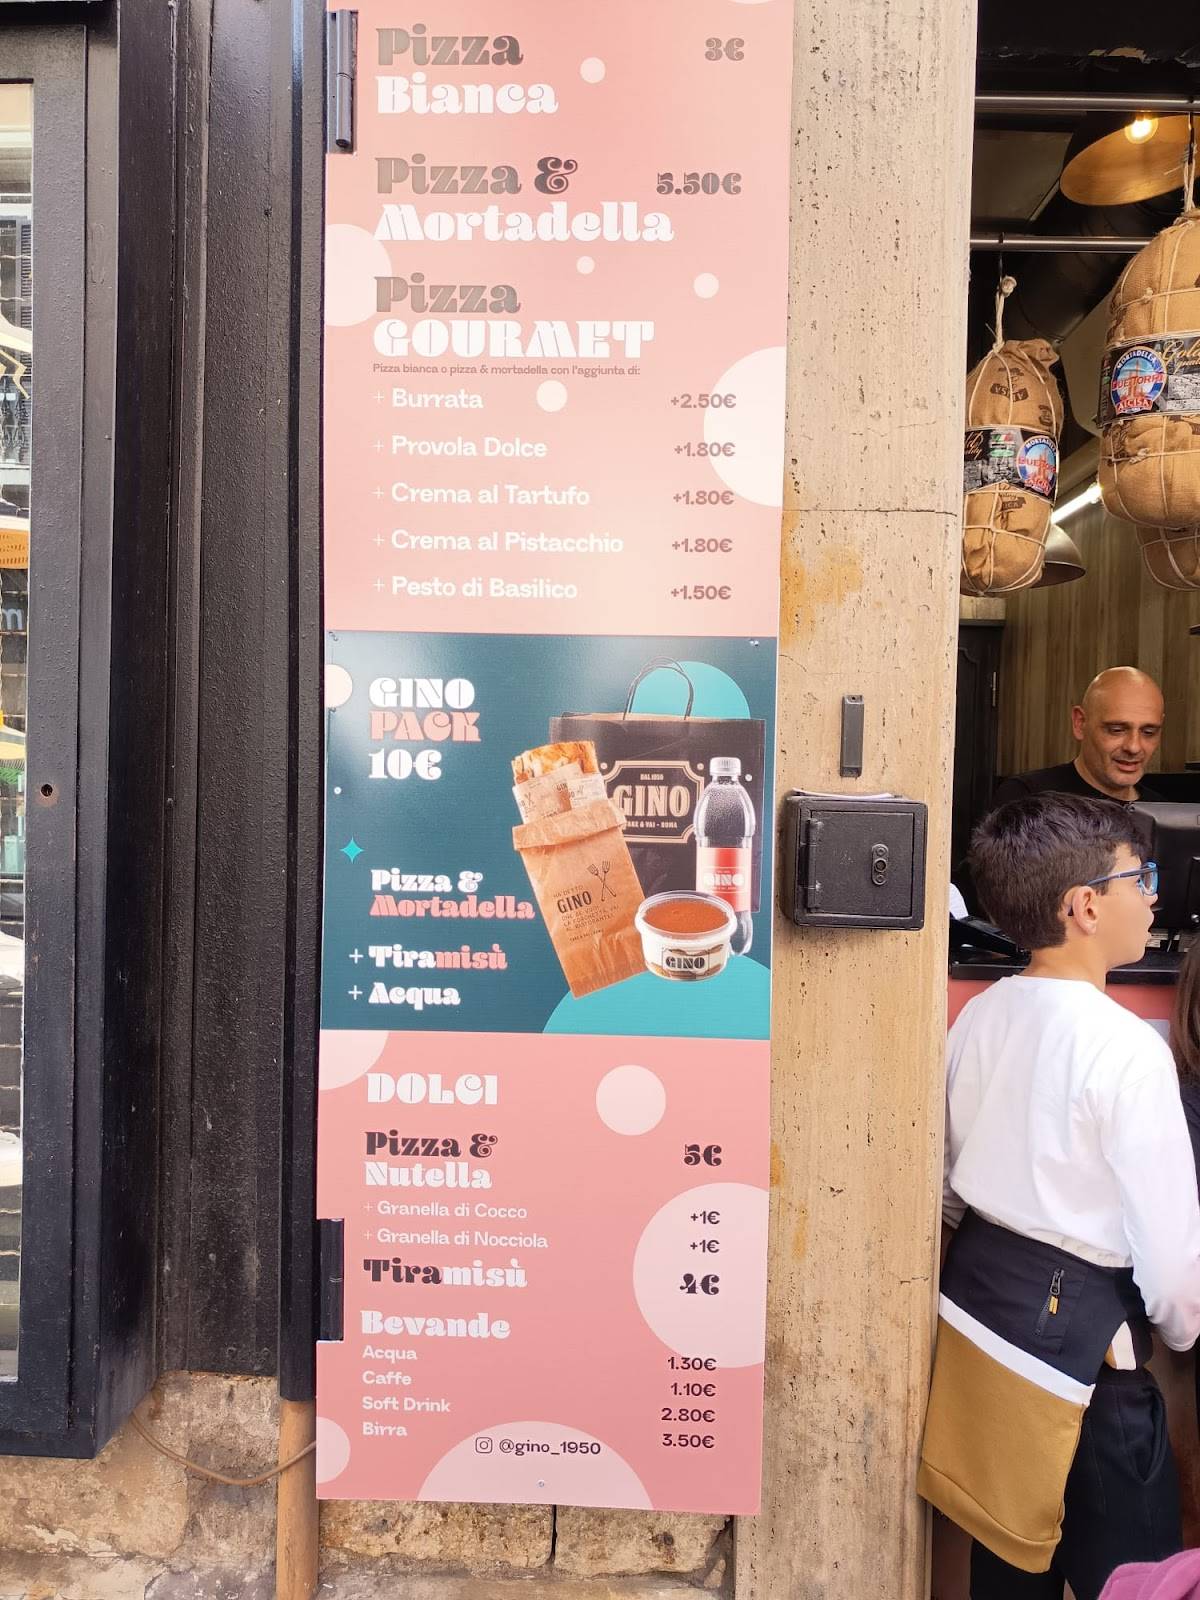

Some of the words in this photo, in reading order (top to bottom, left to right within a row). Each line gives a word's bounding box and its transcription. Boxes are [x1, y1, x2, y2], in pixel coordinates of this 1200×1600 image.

[376, 24, 524, 66] Pizza
[704, 37, 745, 62] 3€
[376, 72, 558, 115] Bianca
[375, 153, 522, 195] Pizza
[534, 156, 578, 194] &
[656, 172, 742, 195] 5.50€
[373, 202, 674, 242] Mortadella
[374, 272, 522, 314] Pizza
[373, 320, 655, 358] GOURMET
[373, 364, 400, 373] Pizza
[403, 364, 438, 374] bianca
[450, 365, 477, 376] pizza
[480, 365, 488, 374] &
[491, 365, 548, 375] mortadella
[551, 367, 569, 375] con
[572, 365, 625, 378] l'aggiunta
[627, 366, 641, 375] di:
[392, 388, 484, 409] Burrata
[670, 393, 736, 410] +2.50€
[392, 436, 477, 458] Provola
[484, 438, 548, 458] Dolce
[674, 442, 736, 458] +1.80€
[391, 483, 472, 504] Crema
[478, 484, 498, 504] al
[504, 484, 590, 506] Tartufo
[672, 490, 734, 506] +1.80€
[391, 530, 472, 551] Crema
[478, 530, 498, 552] al
[504, 531, 624, 554] Pistacchio
[672, 538, 733, 554] +1.80€
[392, 576, 456, 597] Pesto
[462, 576, 483, 598] di
[489, 578, 578, 600] Basilico
[670, 585, 732, 600] +1.50€
[368, 678, 475, 708] GINO
[370, 711, 481, 742] PACK
[368, 748, 442, 780] 10€
[612, 785, 690, 817] GINO
[370, 868, 453, 893] Pizza
[457, 870, 484, 892] &
[370, 894, 536, 920] Mortadella
[557, 890, 592, 914] GINO
[368, 944, 508, 970] Tiramisù
[665, 956, 706, 970] GINO
[368, 982, 462, 1010] Acqua
[366, 1072, 498, 1106] DOLCI
[364, 1129, 462, 1157] Pizza
[469, 1133, 498, 1158] &
[684, 1144, 722, 1166] 5€
[364, 1161, 492, 1190] Nutella
[377, 1200, 450, 1218] Granella
[454, 1201, 470, 1218] di
[474, 1202, 528, 1219] Cocco
[690, 1210, 720, 1224] +1€
[376, 1228, 450, 1246] Granella
[454, 1230, 470, 1246] di
[474, 1231, 549, 1248] Nocciola
[690, 1239, 720, 1254] +1€
[363, 1256, 528, 1288] Tiramisù
[679, 1272, 720, 1296] 4€
[360, 1310, 510, 1340] Bevande
[362, 1345, 418, 1364] Acqua
[666, 1356, 718, 1372] 1.30€
[362, 1370, 412, 1386] Caffe
[670, 1382, 716, 1398] 1.10€
[362, 1396, 399, 1412] Soft
[403, 1397, 451, 1413] Drink
[660, 1408, 716, 1424] 2.80€
[362, 1422, 408, 1437] Birra
[499, 1438, 601, 1456] @gino_1950
[661, 1433, 716, 1450] 3.50€
